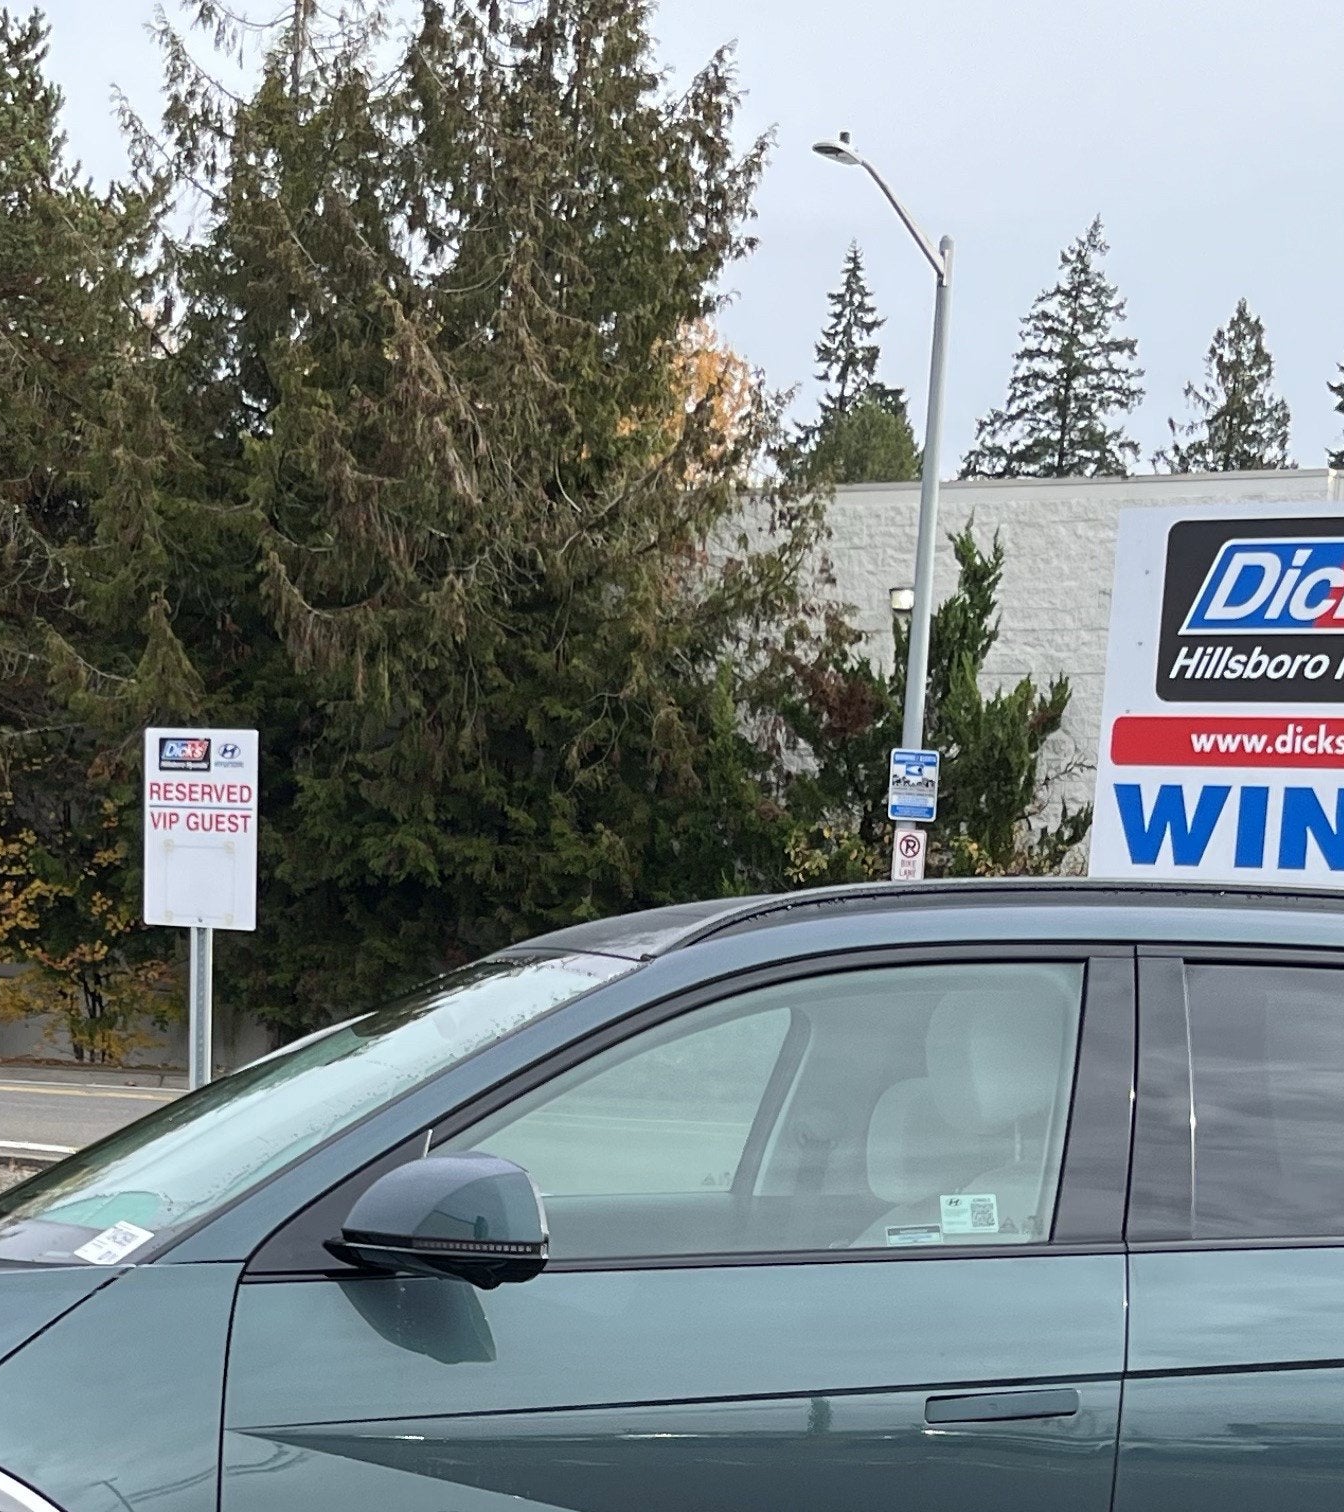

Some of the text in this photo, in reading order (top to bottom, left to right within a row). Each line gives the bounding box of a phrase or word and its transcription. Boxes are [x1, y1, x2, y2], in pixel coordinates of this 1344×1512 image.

[1169, 646, 1330, 681] Hillsboro
[149, 782, 252, 803] RESERVED
[150, 812, 251, 833] VIP GUEST
